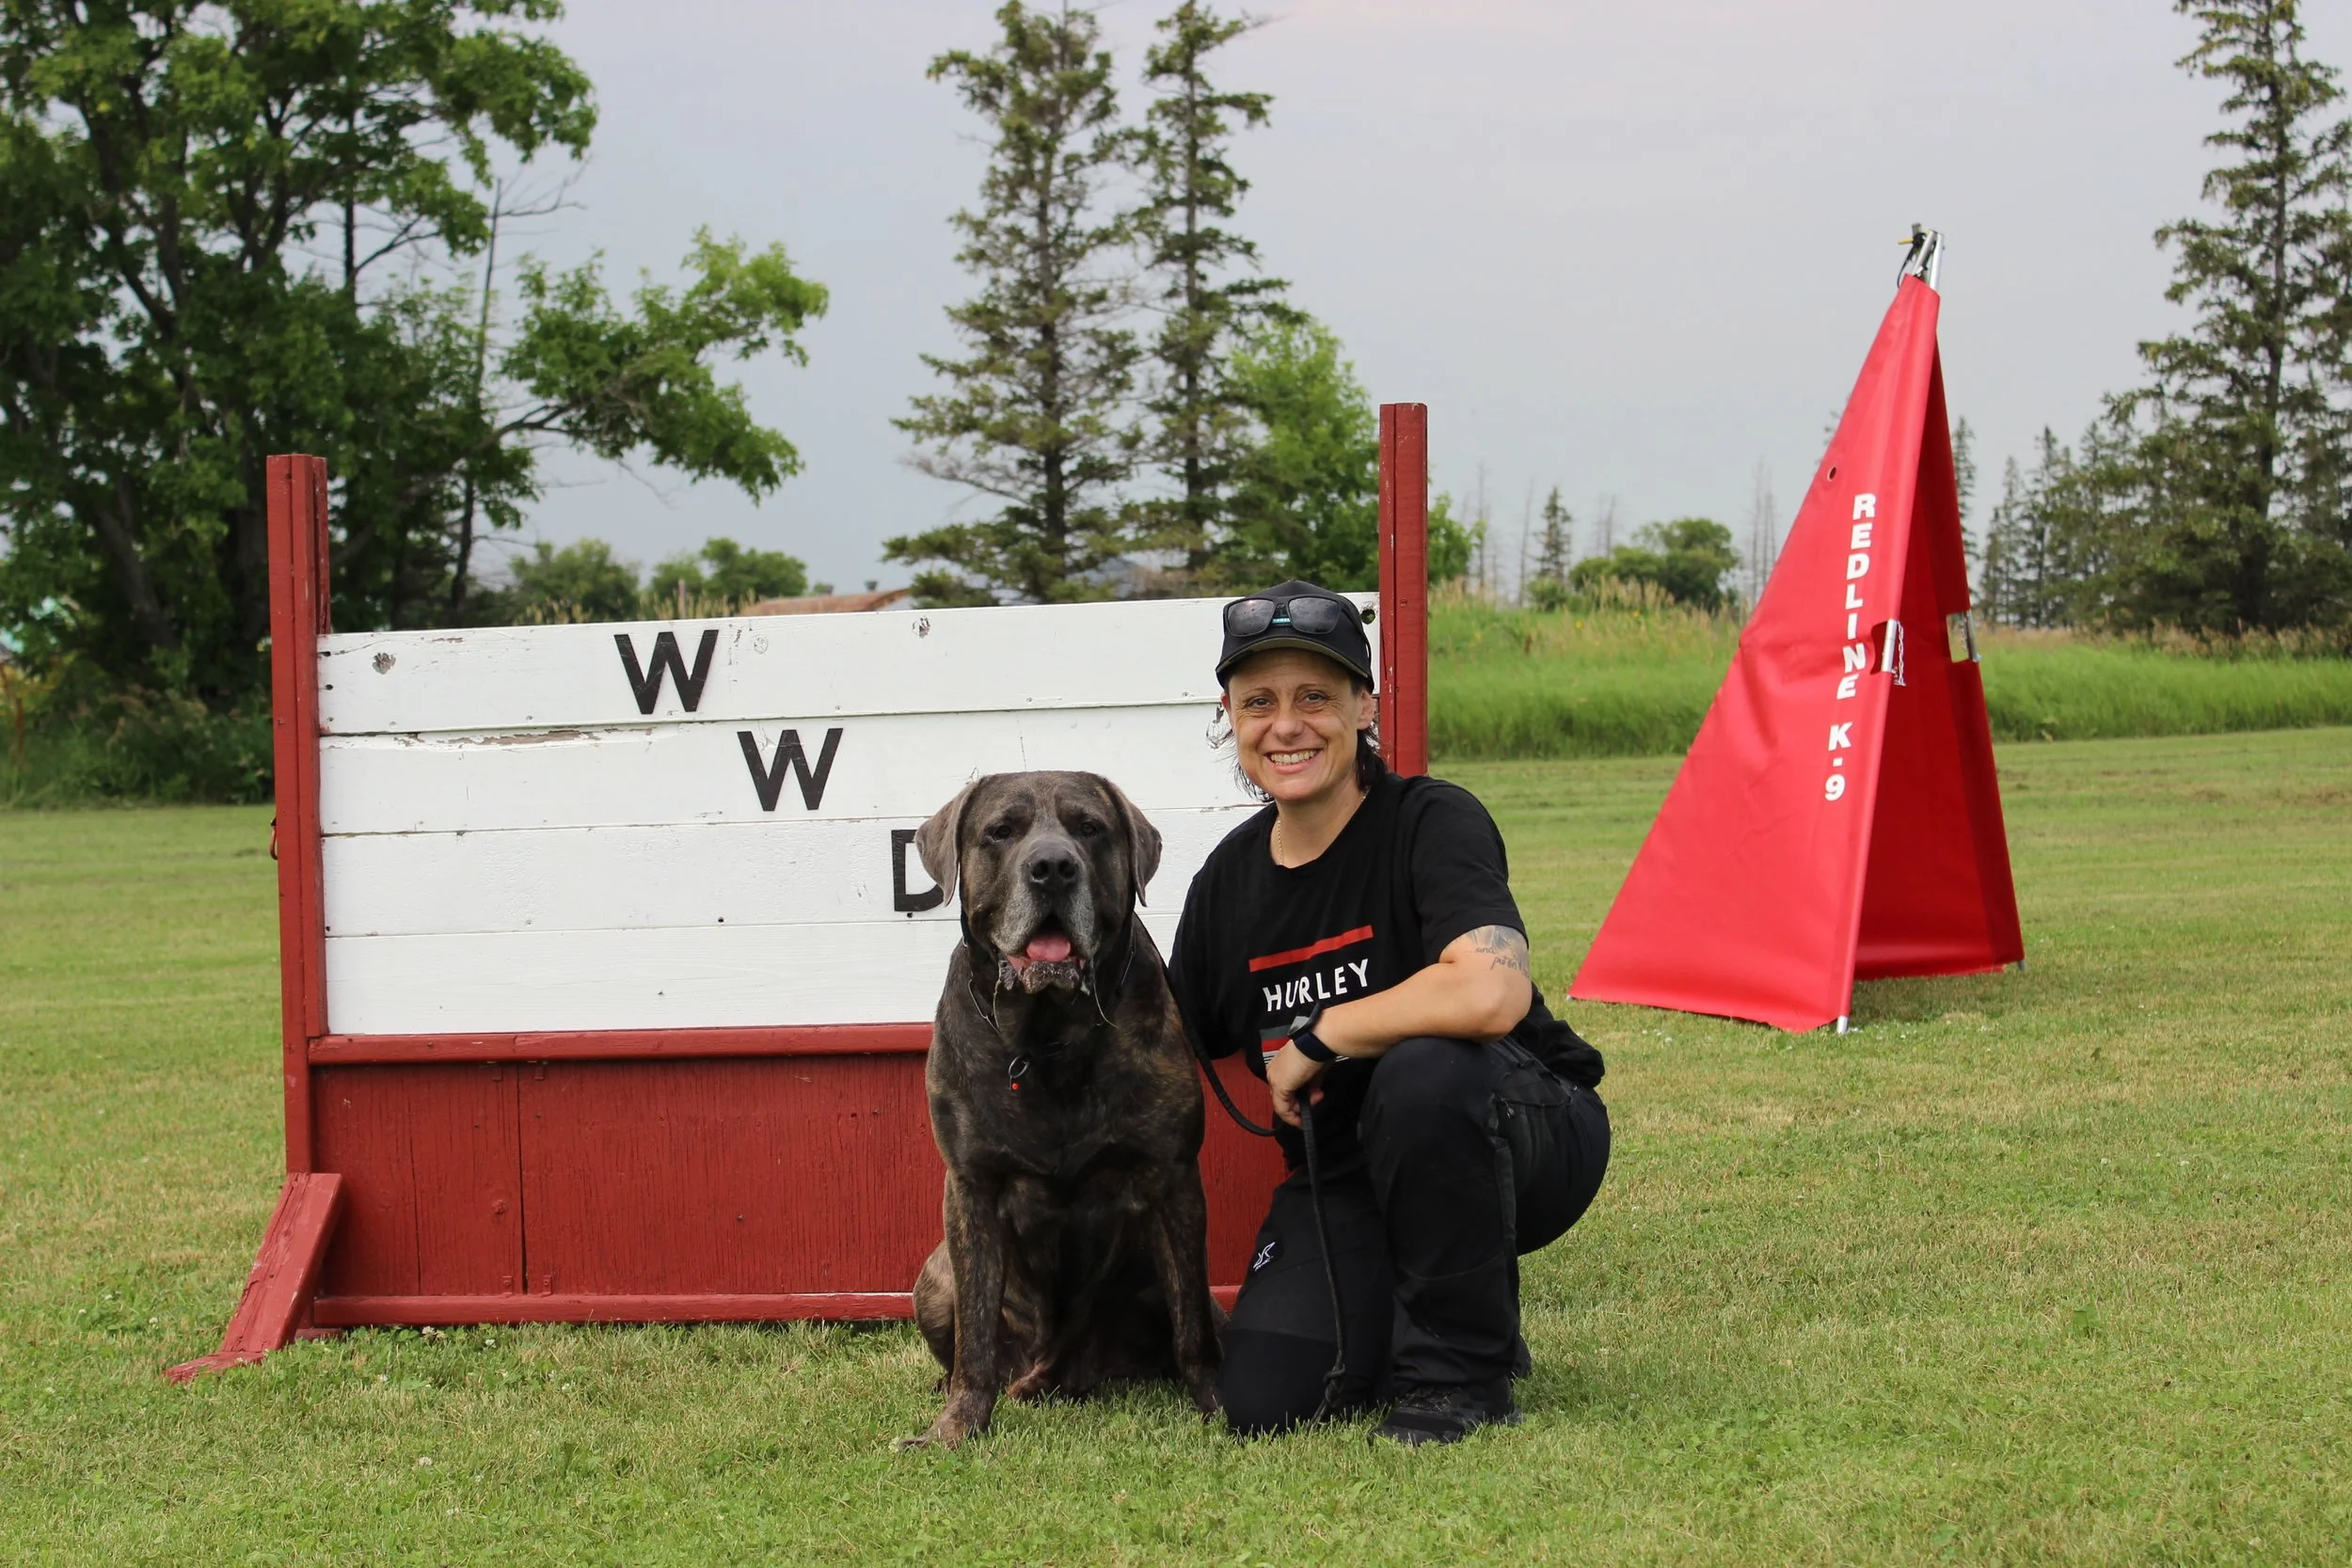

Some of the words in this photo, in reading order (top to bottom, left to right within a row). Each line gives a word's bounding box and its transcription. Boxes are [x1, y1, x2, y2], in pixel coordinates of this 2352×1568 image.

[1836, 493, 1876, 700] REDLINE
[613, 629, 719, 715] W
[737, 728, 843, 812] W
[1824, 721, 1852, 801] K-9
[1263, 958, 1369, 1012] HURLEY
